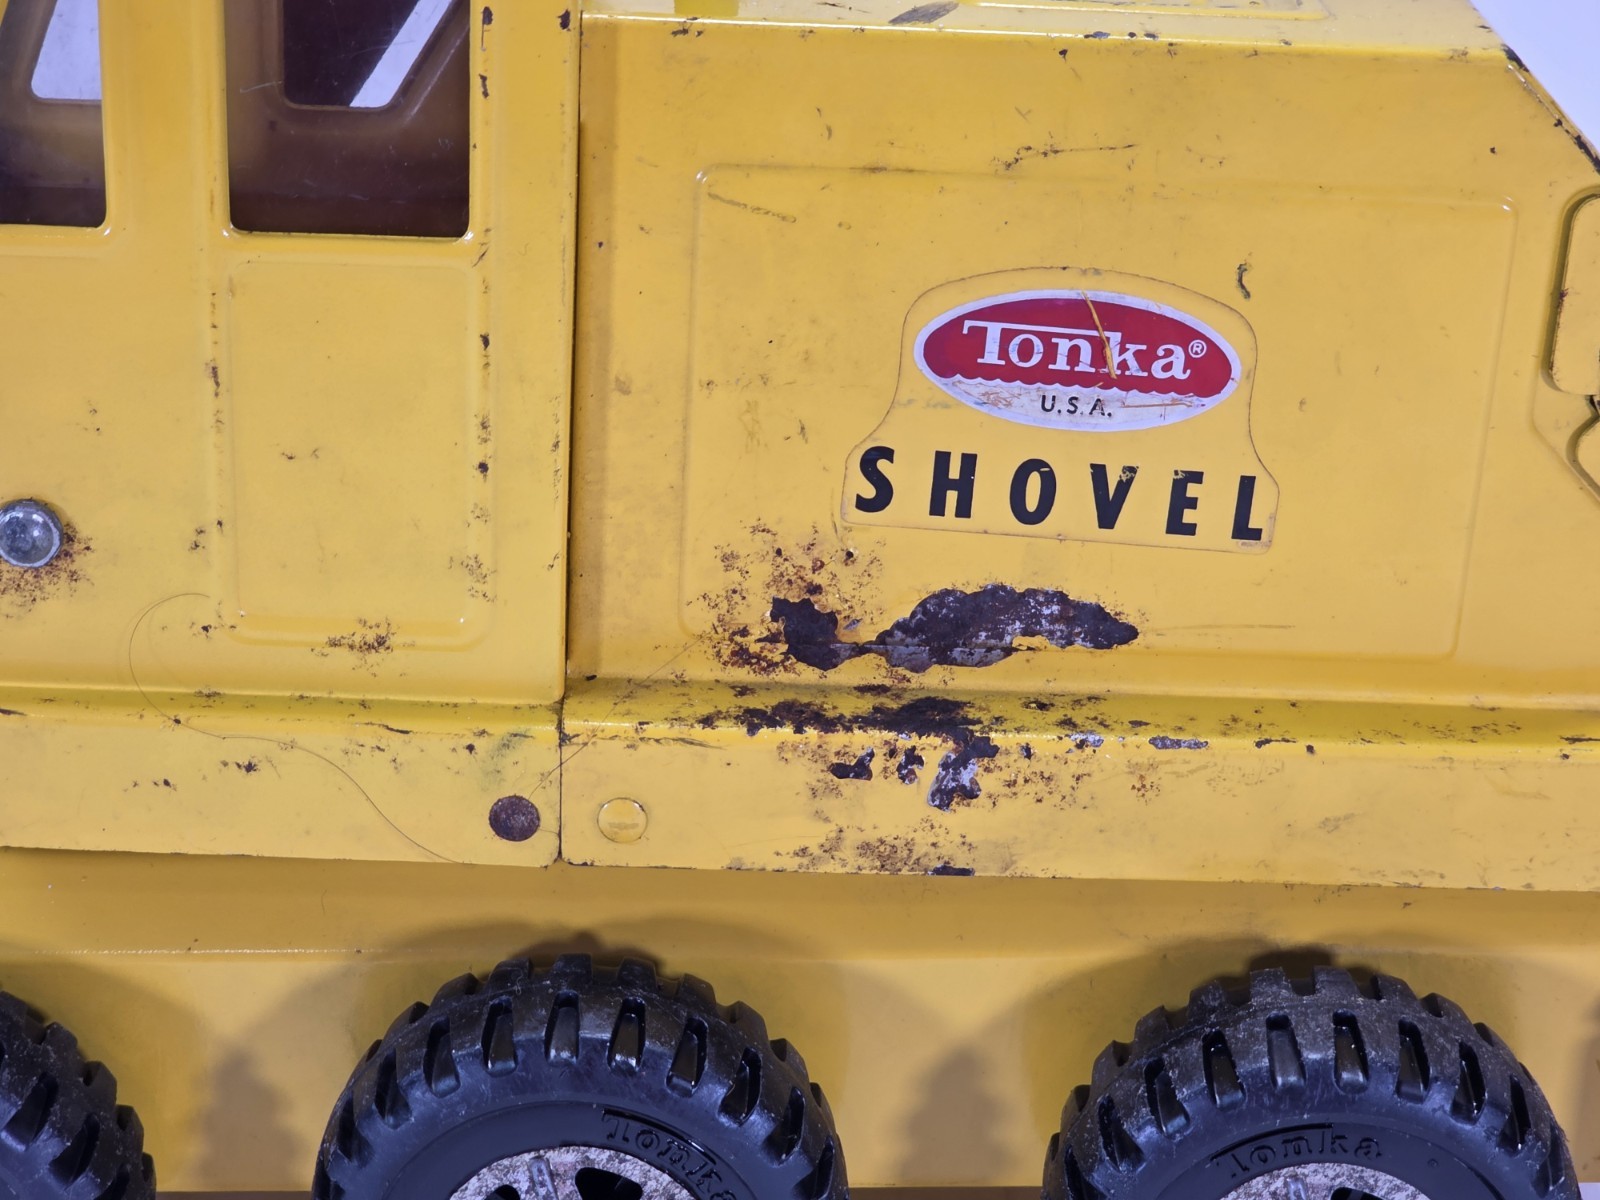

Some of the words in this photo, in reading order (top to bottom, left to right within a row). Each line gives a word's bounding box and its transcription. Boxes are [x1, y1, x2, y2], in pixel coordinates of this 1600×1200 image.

[1040, 394, 1112, 417] U.S.A.
[855, 445, 1263, 541] SHOVEL
[1210, 1122, 1382, 1178] Tonka
